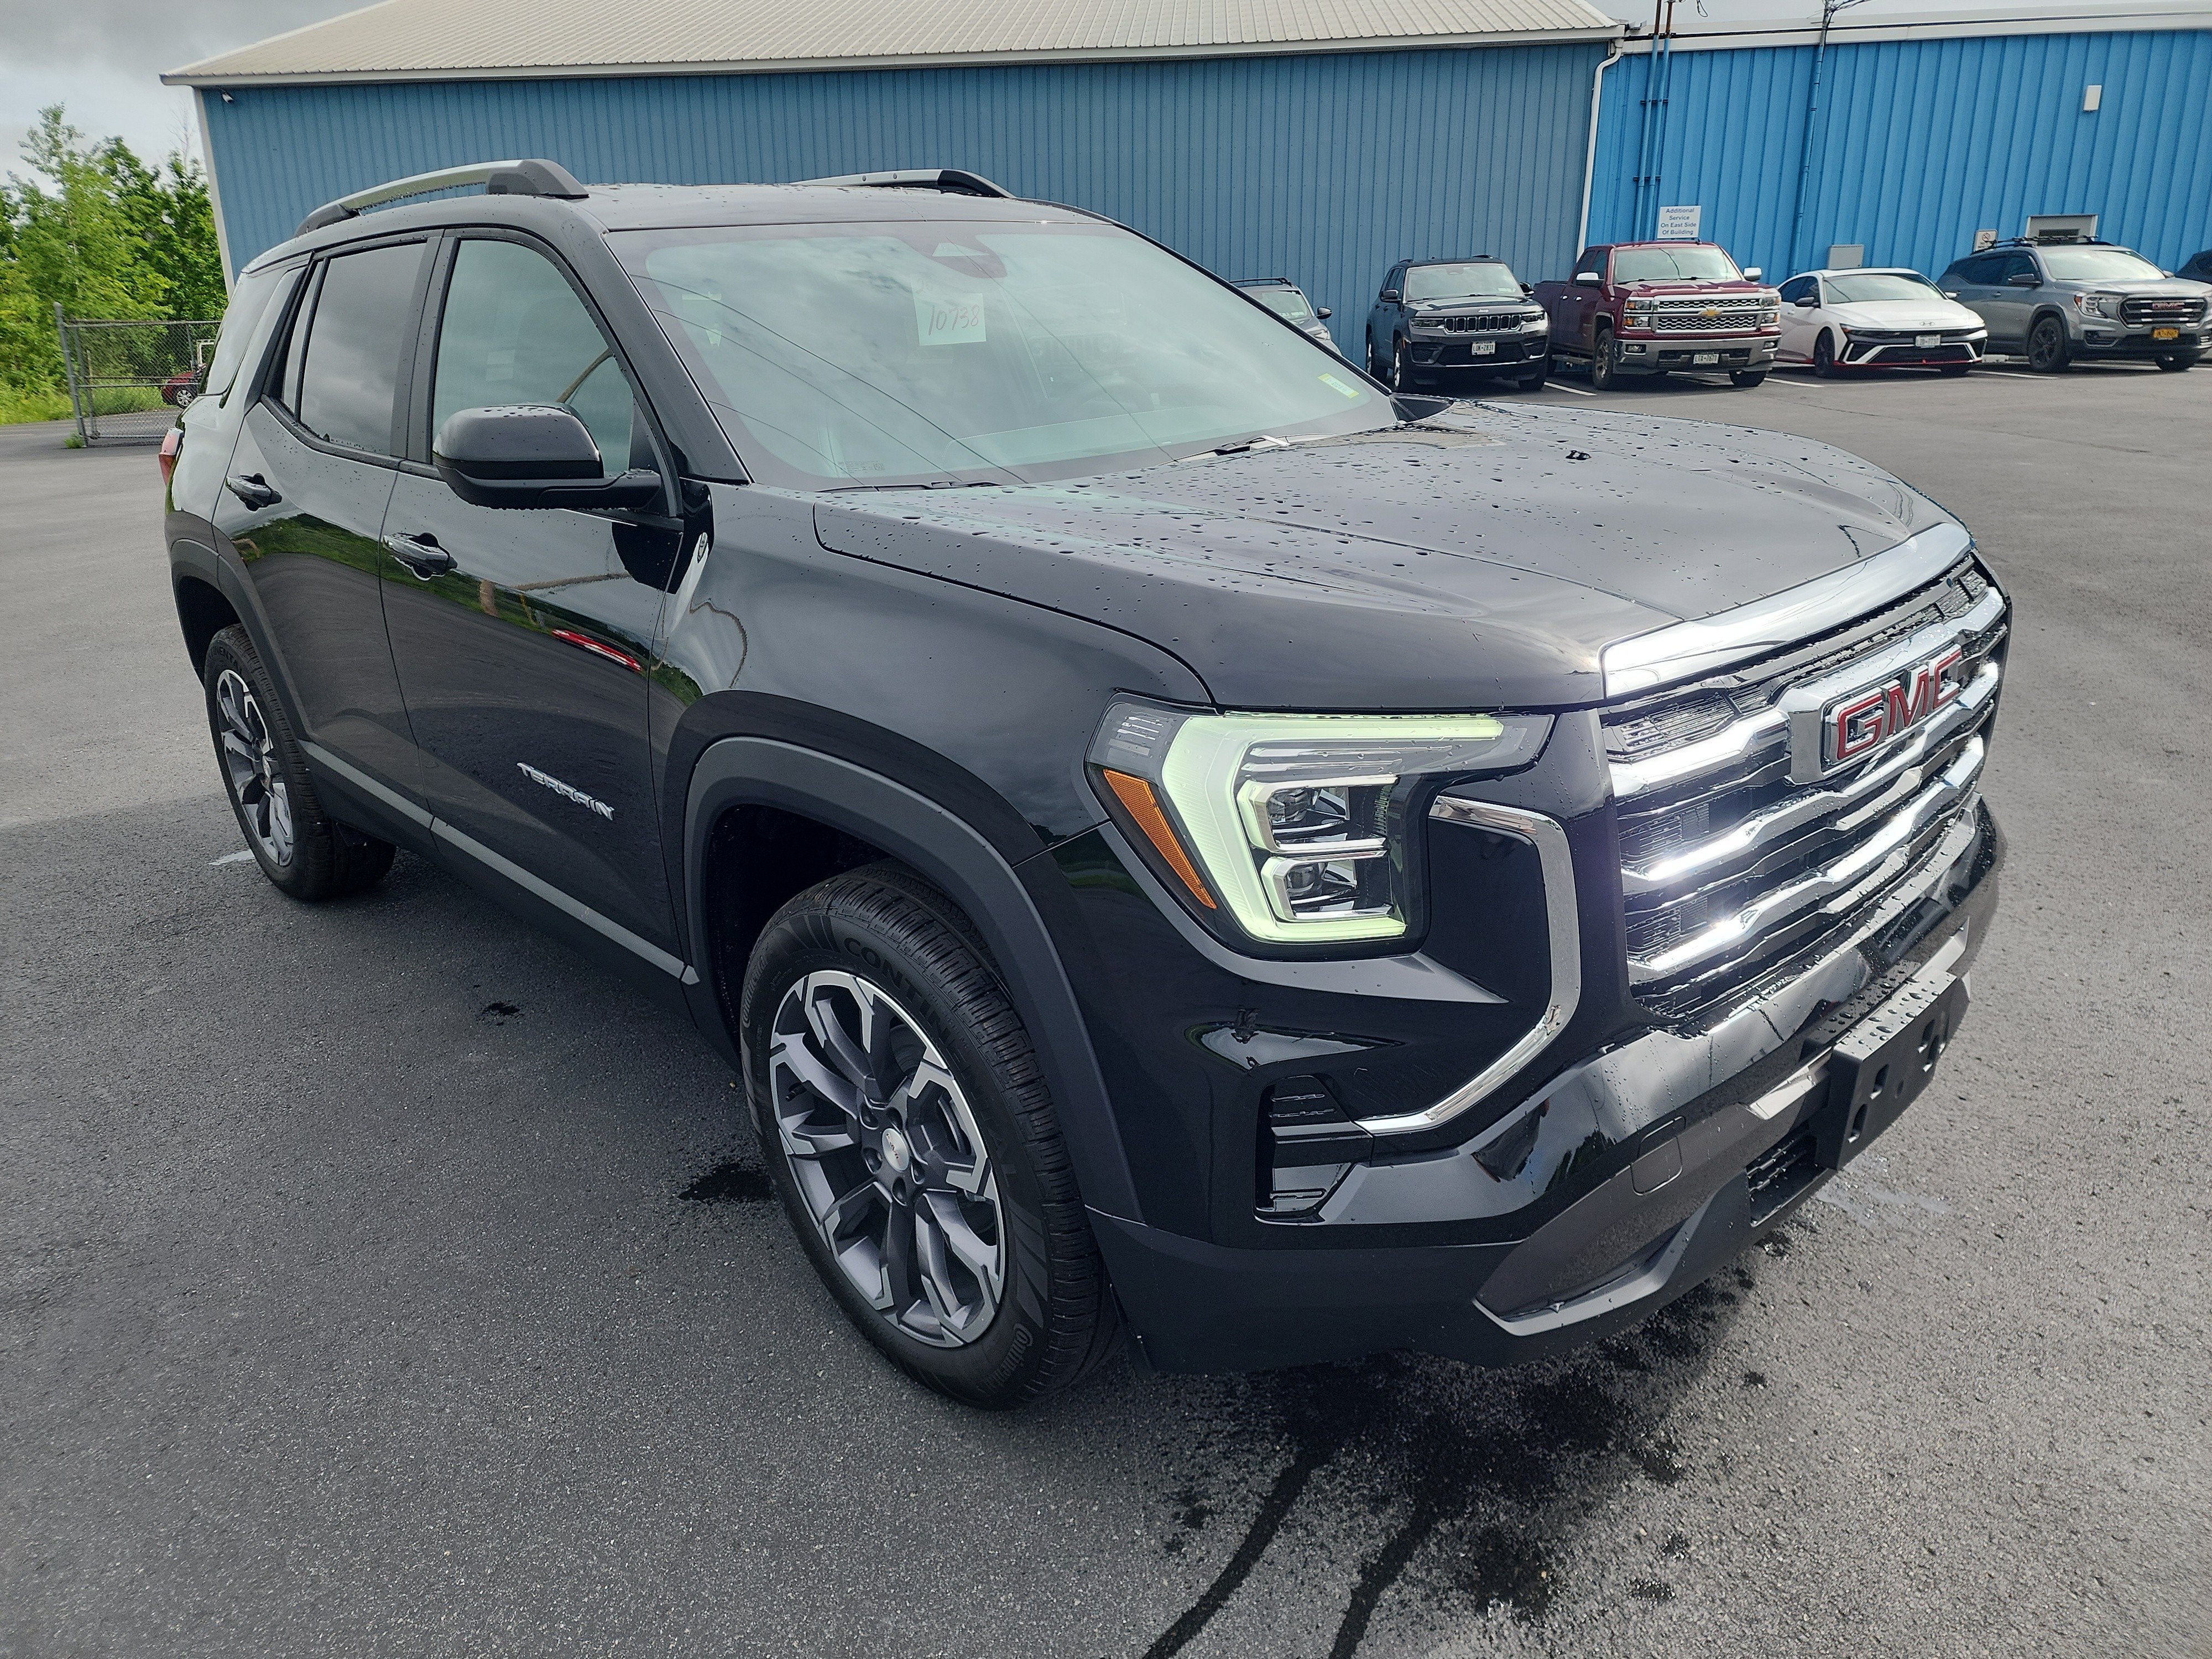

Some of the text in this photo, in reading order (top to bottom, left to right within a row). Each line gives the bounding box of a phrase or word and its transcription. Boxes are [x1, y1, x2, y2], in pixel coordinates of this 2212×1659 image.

[928, 304, 980, 336] 10738
[1837, 645, 1962, 760] GMC
[517, 762, 614, 821] TERRAIN
